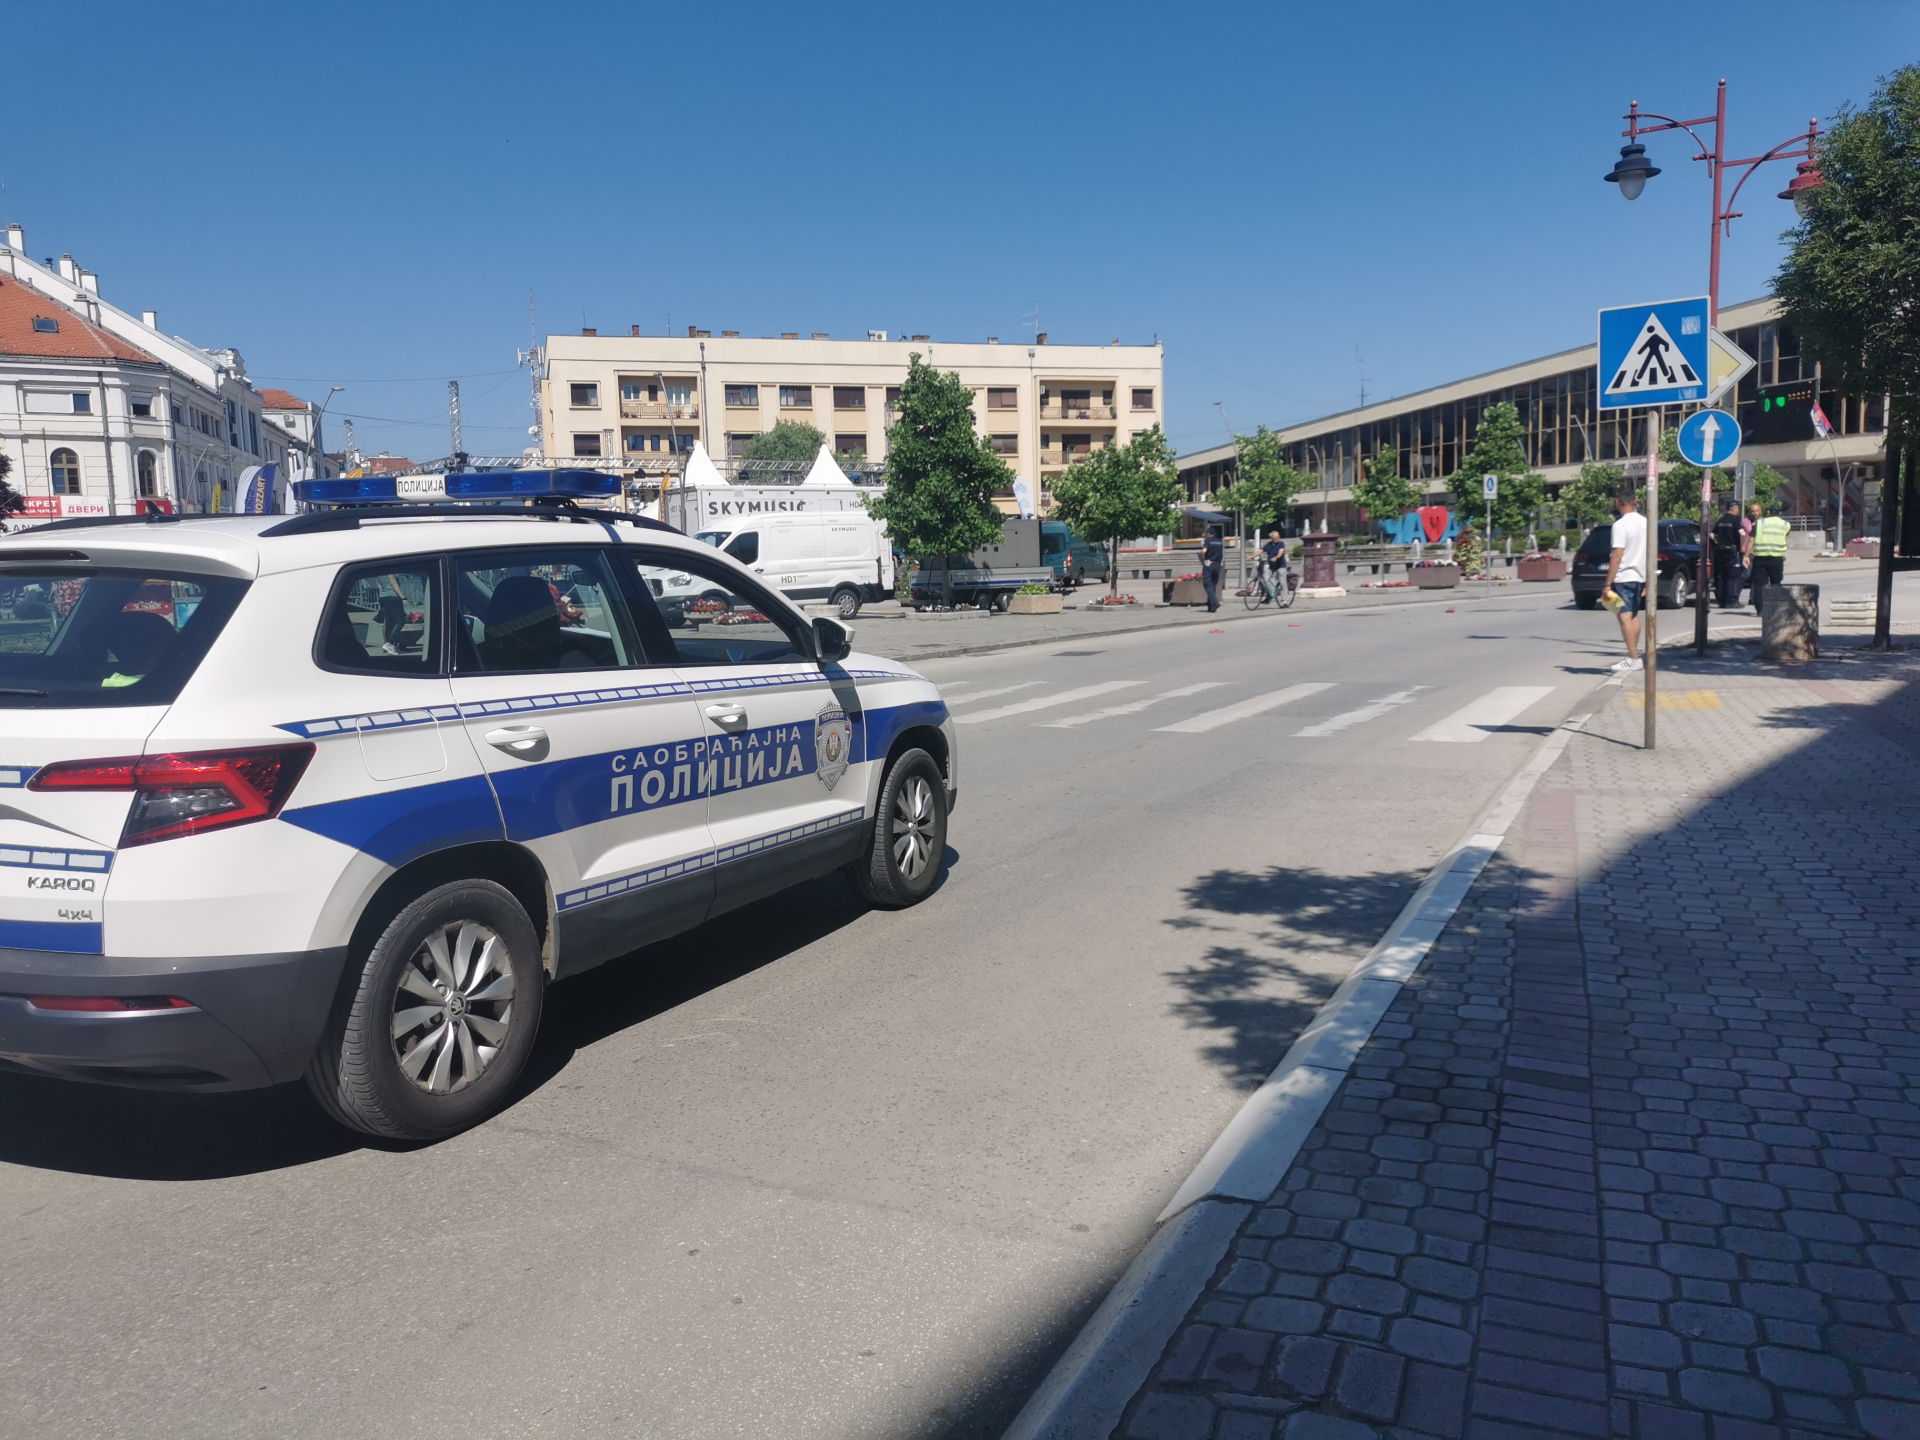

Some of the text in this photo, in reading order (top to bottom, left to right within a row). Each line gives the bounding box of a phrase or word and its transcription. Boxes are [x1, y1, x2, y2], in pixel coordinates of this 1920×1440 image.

[398, 480, 444, 494] ПОЛИЦИЈА
[67, 505, 104, 514] ДВЕРИ
[708, 500, 806, 516] SKYMUSIC
[781, 575, 797, 584] HD1
[611, 726, 801, 773] САОБРАЋАЈНА
[610, 744, 804, 813] ПОЛИЦИЈА
[28, 876, 95, 892] KAROQ
[58, 909, 93, 921] 4x4
